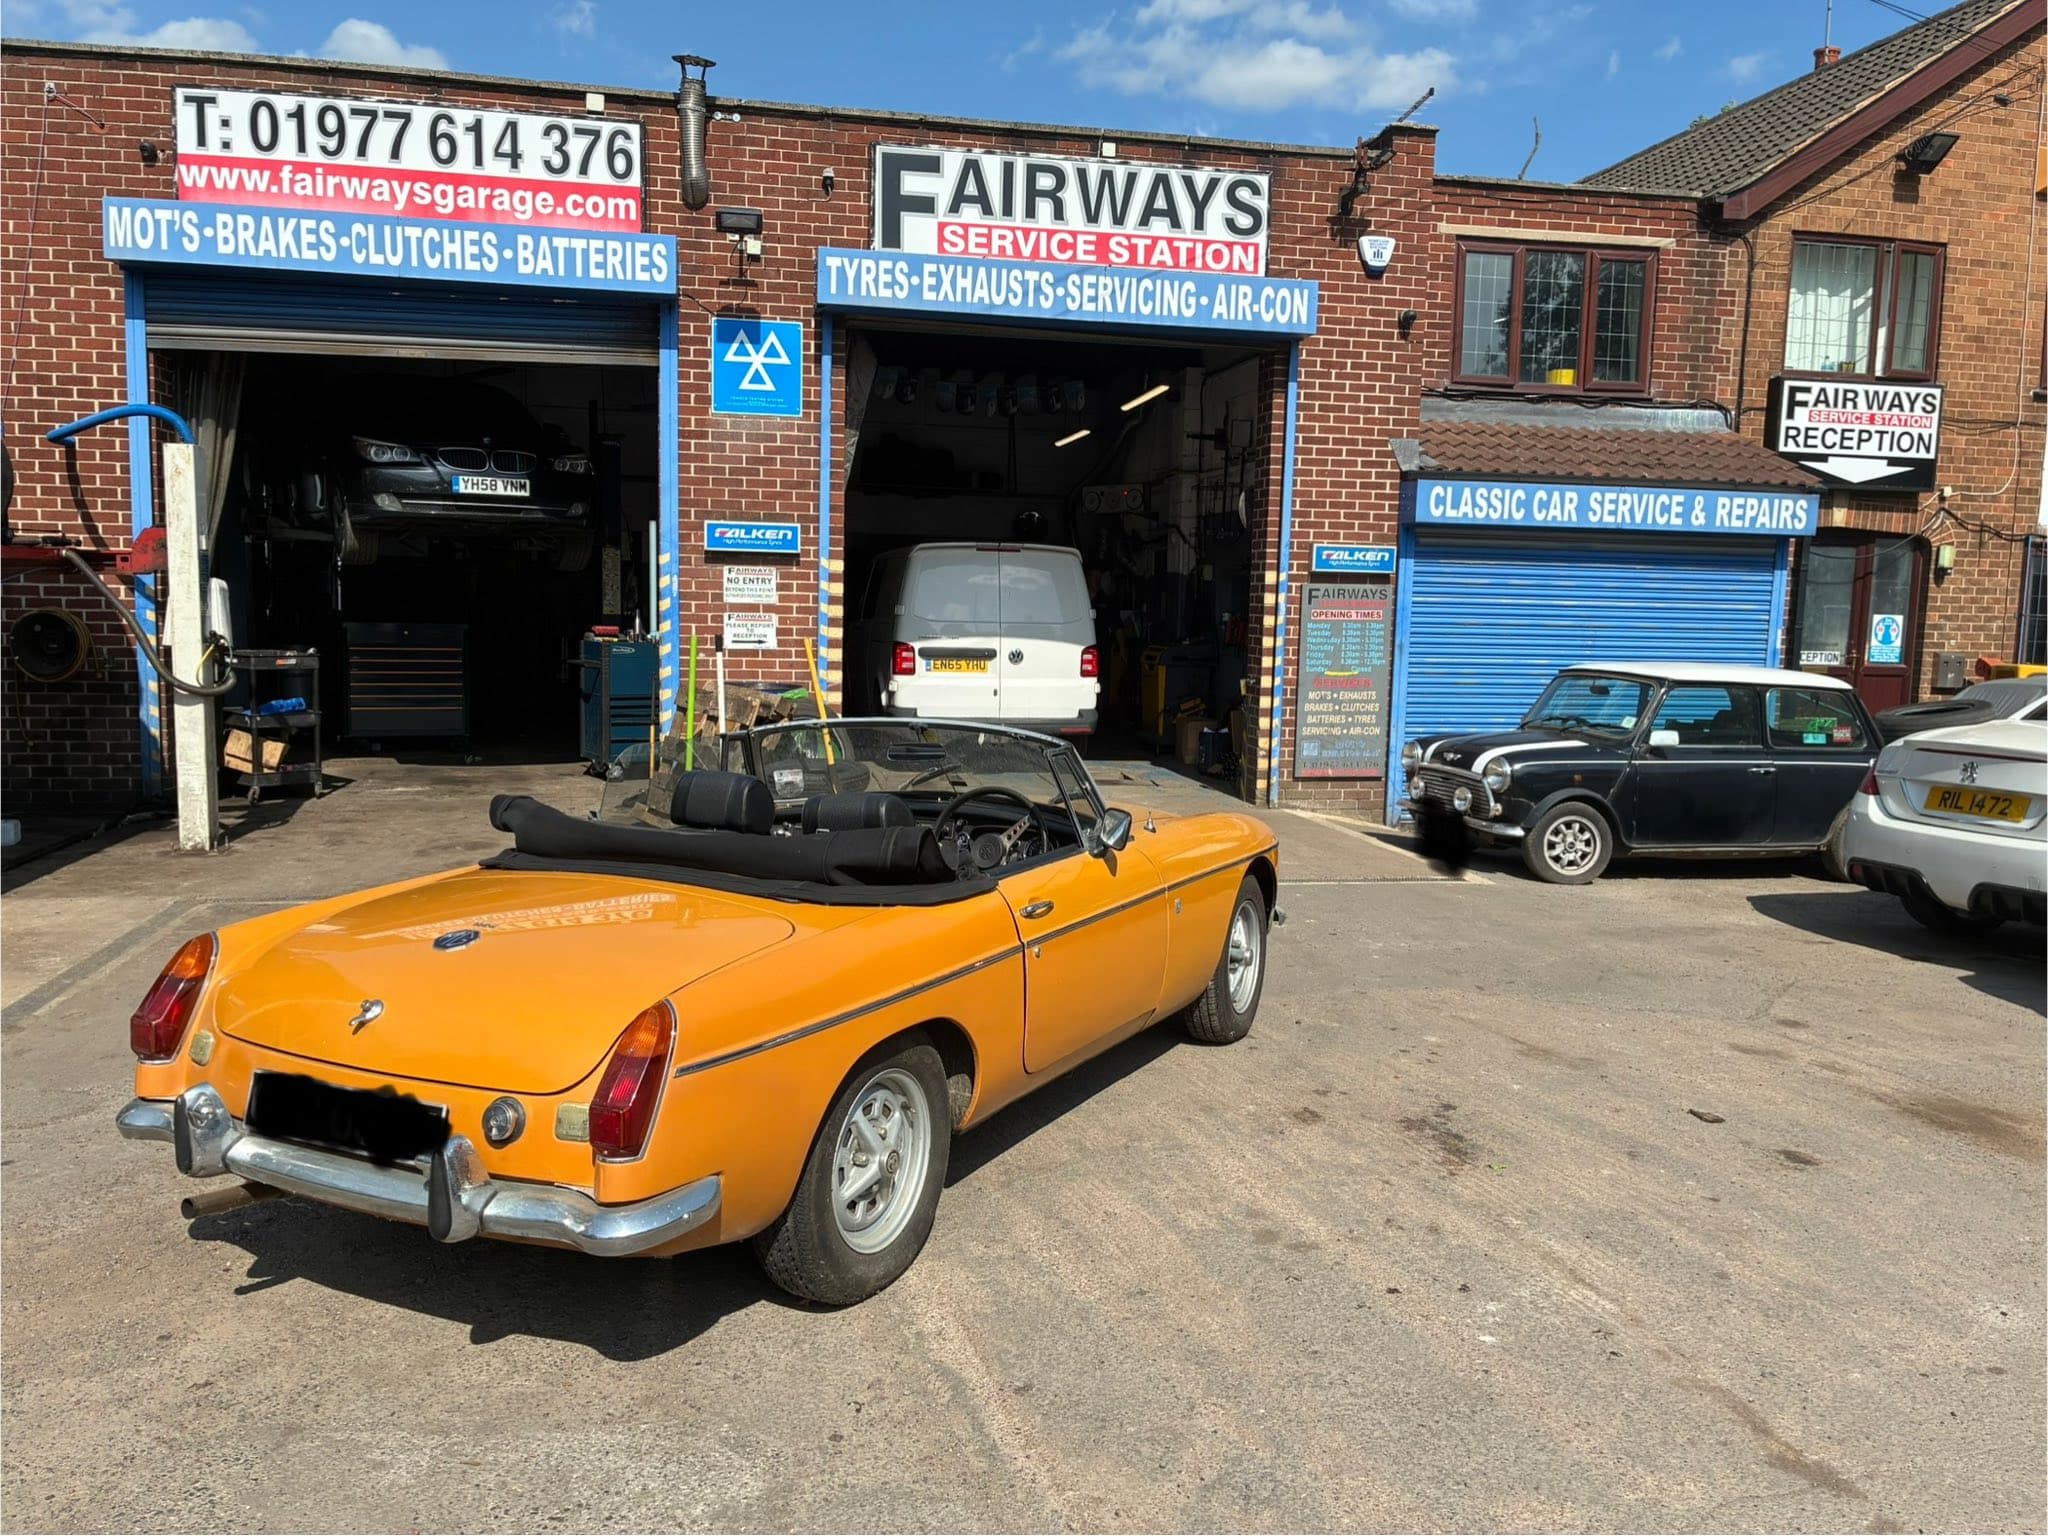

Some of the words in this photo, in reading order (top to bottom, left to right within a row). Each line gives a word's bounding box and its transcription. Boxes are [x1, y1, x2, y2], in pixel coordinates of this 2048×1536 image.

[181, 92, 233, 152] T:
[249, 97, 414, 163] 01977
[427, 110, 525, 173] 614
[541, 121, 634, 183] 376
[178, 163, 637, 221] www.fairwaysgarage.com
[878, 149, 1266, 250] FAIRWAYS
[108, 206, 200, 252] MOT'S
[215, 212, 337, 262] BRAKES
[350, 222, 499, 273] CLUTCHES
[517, 234, 669, 282] BATTERIES
[942, 224, 1097, 262] SERVICE
[1108, 235, 1255, 273] STATION
[825, 256, 910, 299] TYRES
[922, 262, 1054, 310] EXHAUSTS
[1066, 273, 1196, 319] SERVICING
[1211, 282, 1309, 325] AIR-CON
[1809, 410, 1871, 424] SERVICE
[1874, 413, 1931, 428] STATION
[1783, 425, 1932, 454] RECEPTION
[462, 477, 498, 492] YH58
[501, 479, 527, 493] VNM
[1429, 485, 1526, 521] CLASSIC
[1532, 489, 1579, 523] CAR
[1587, 491, 1685, 526] SERVICE
[1690, 494, 1706, 527] &
[1714, 496, 1808, 531] REPAIRS
[714, 527, 793, 540] FALKEN
[1321, 550, 1390, 561] FALKEN
[727, 576, 740, 585] NO
[742, 576, 773, 585] ENTRY
[1308, 587, 1388, 605] FAIRWAYS
[1312, 610, 1353, 619] OPENING
[1355, 611, 1382, 619] TIMES
[932, 658, 962, 670] EN65
[1339, 691, 1377, 700] EXHAUSTS
[1304, 703, 1334, 712] BRAKES
[1340, 703, 1380, 712] CLUTCHES
[1306, 715, 1346, 724] BATTERIES
[1353, 715, 1377, 724] TYRES
[1302, 726, 1341, 736] SERVICING
[1348, 726, 1381, 736] AIR-CON
[1937, 792, 1964, 810] RIL
[1968, 793, 2013, 816] 1472
